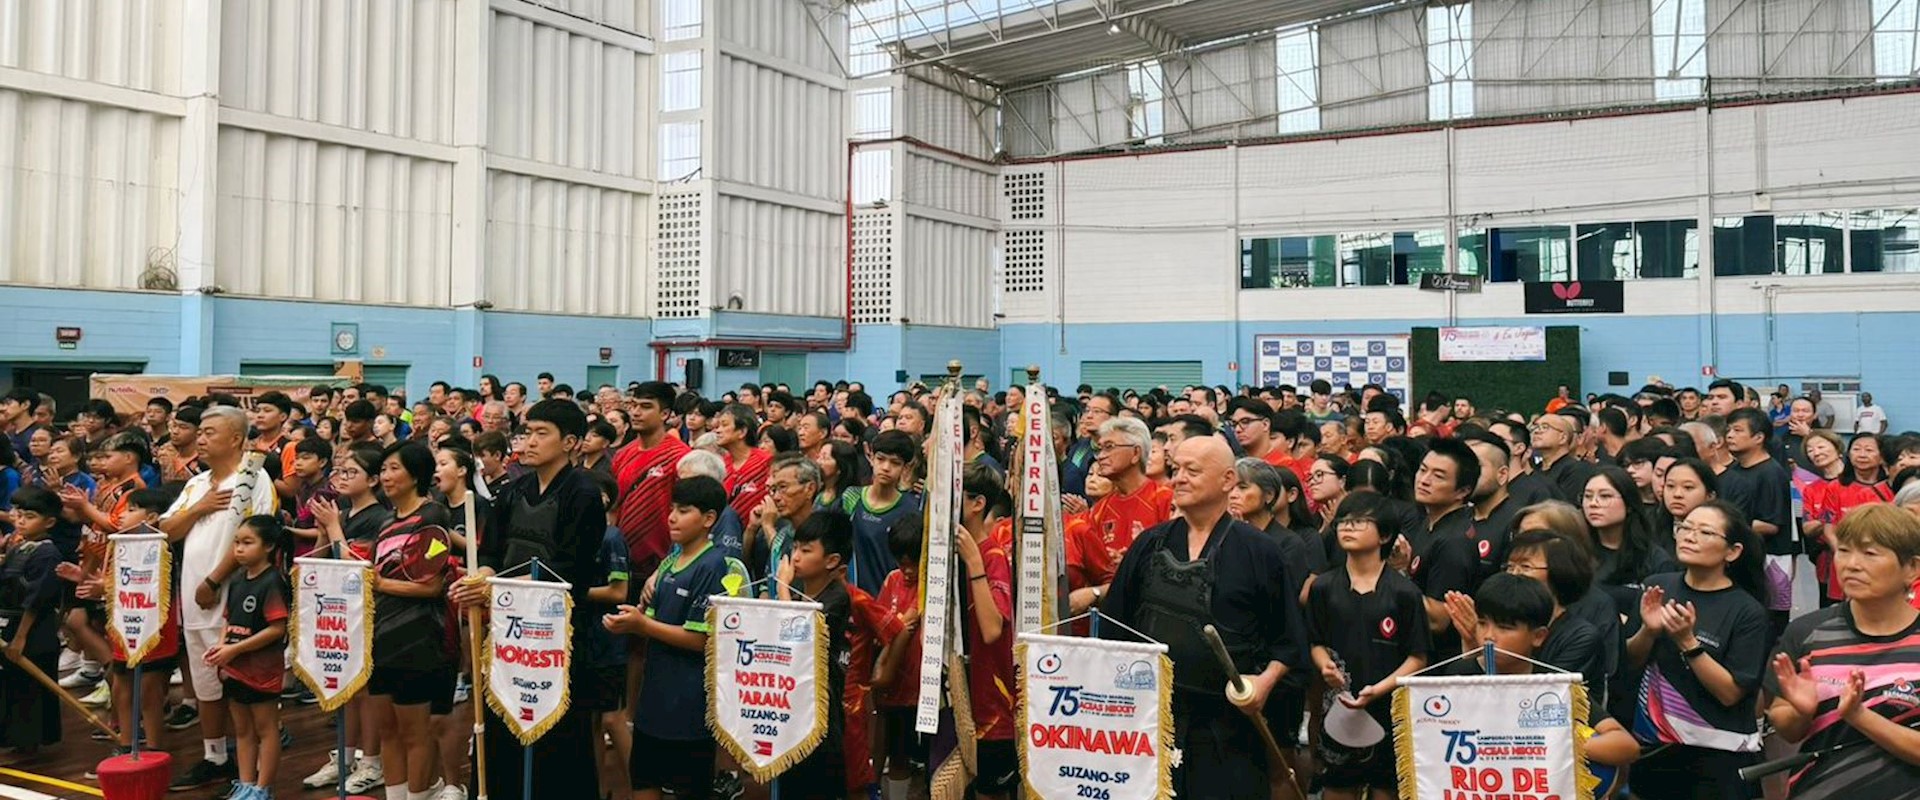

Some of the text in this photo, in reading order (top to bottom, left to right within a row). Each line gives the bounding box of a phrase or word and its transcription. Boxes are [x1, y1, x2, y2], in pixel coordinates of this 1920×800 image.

[1028, 402, 1042, 512] CENTRAL
[930, 556, 946, 566] 2014
[929, 575, 945, 587] 2015
[928, 595, 944, 605] 2016
[505, 615, 523, 639] 75
[927, 615, 943, 627] 2017
[925, 635, 942, 645] 2018
[736, 638, 758, 666] 75
[924, 655, 940, 667] 2019
[735, 669, 795, 690] NORTE DO
[922, 675, 939, 686] 2020
[918, 716, 936, 727] 2022
[752, 724, 778, 737] 2026
[1030, 723, 1155, 757] OKINAWA
[1059, 766, 1130, 784] SUZANO-SP
[1450, 765, 1549, 794] RIO DE
[1077, 784, 1111, 800] 2026
